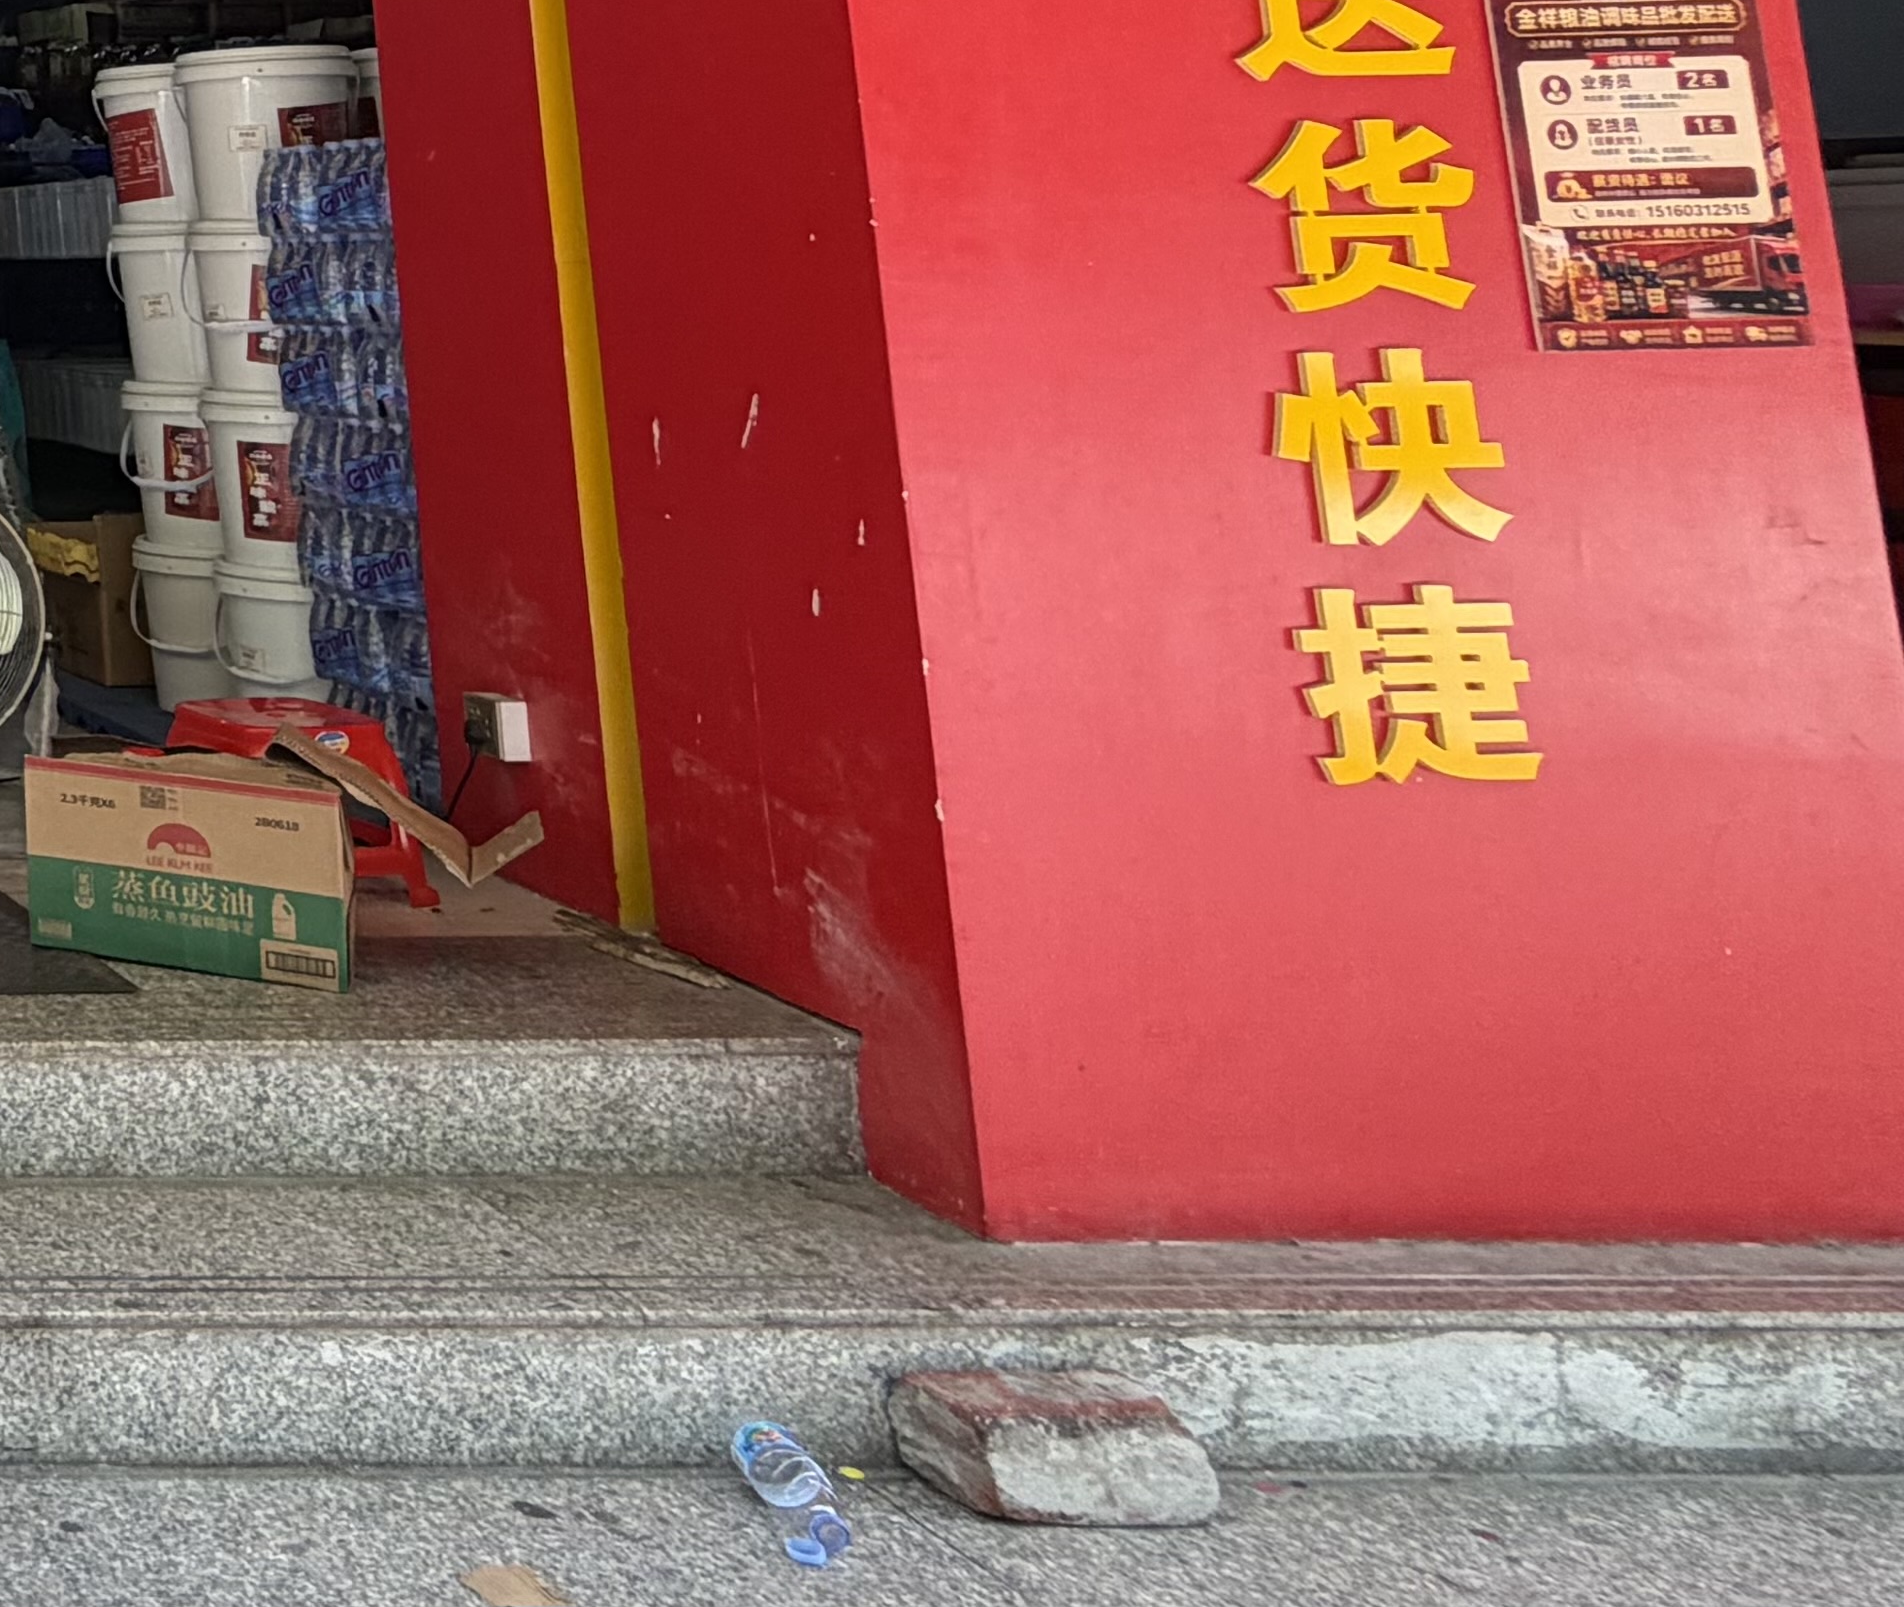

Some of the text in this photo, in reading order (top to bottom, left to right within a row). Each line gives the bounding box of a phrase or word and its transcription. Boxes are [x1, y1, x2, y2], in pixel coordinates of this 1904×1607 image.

[1580, 73, 1633, 90] 业务员
[1686, 71, 1718, 88] 2名
[1586, 117, 1640, 135] 配货员
[1694, 117, 1725, 133] 1名
[112, 869, 255, 920] 蒸鱼豉油
